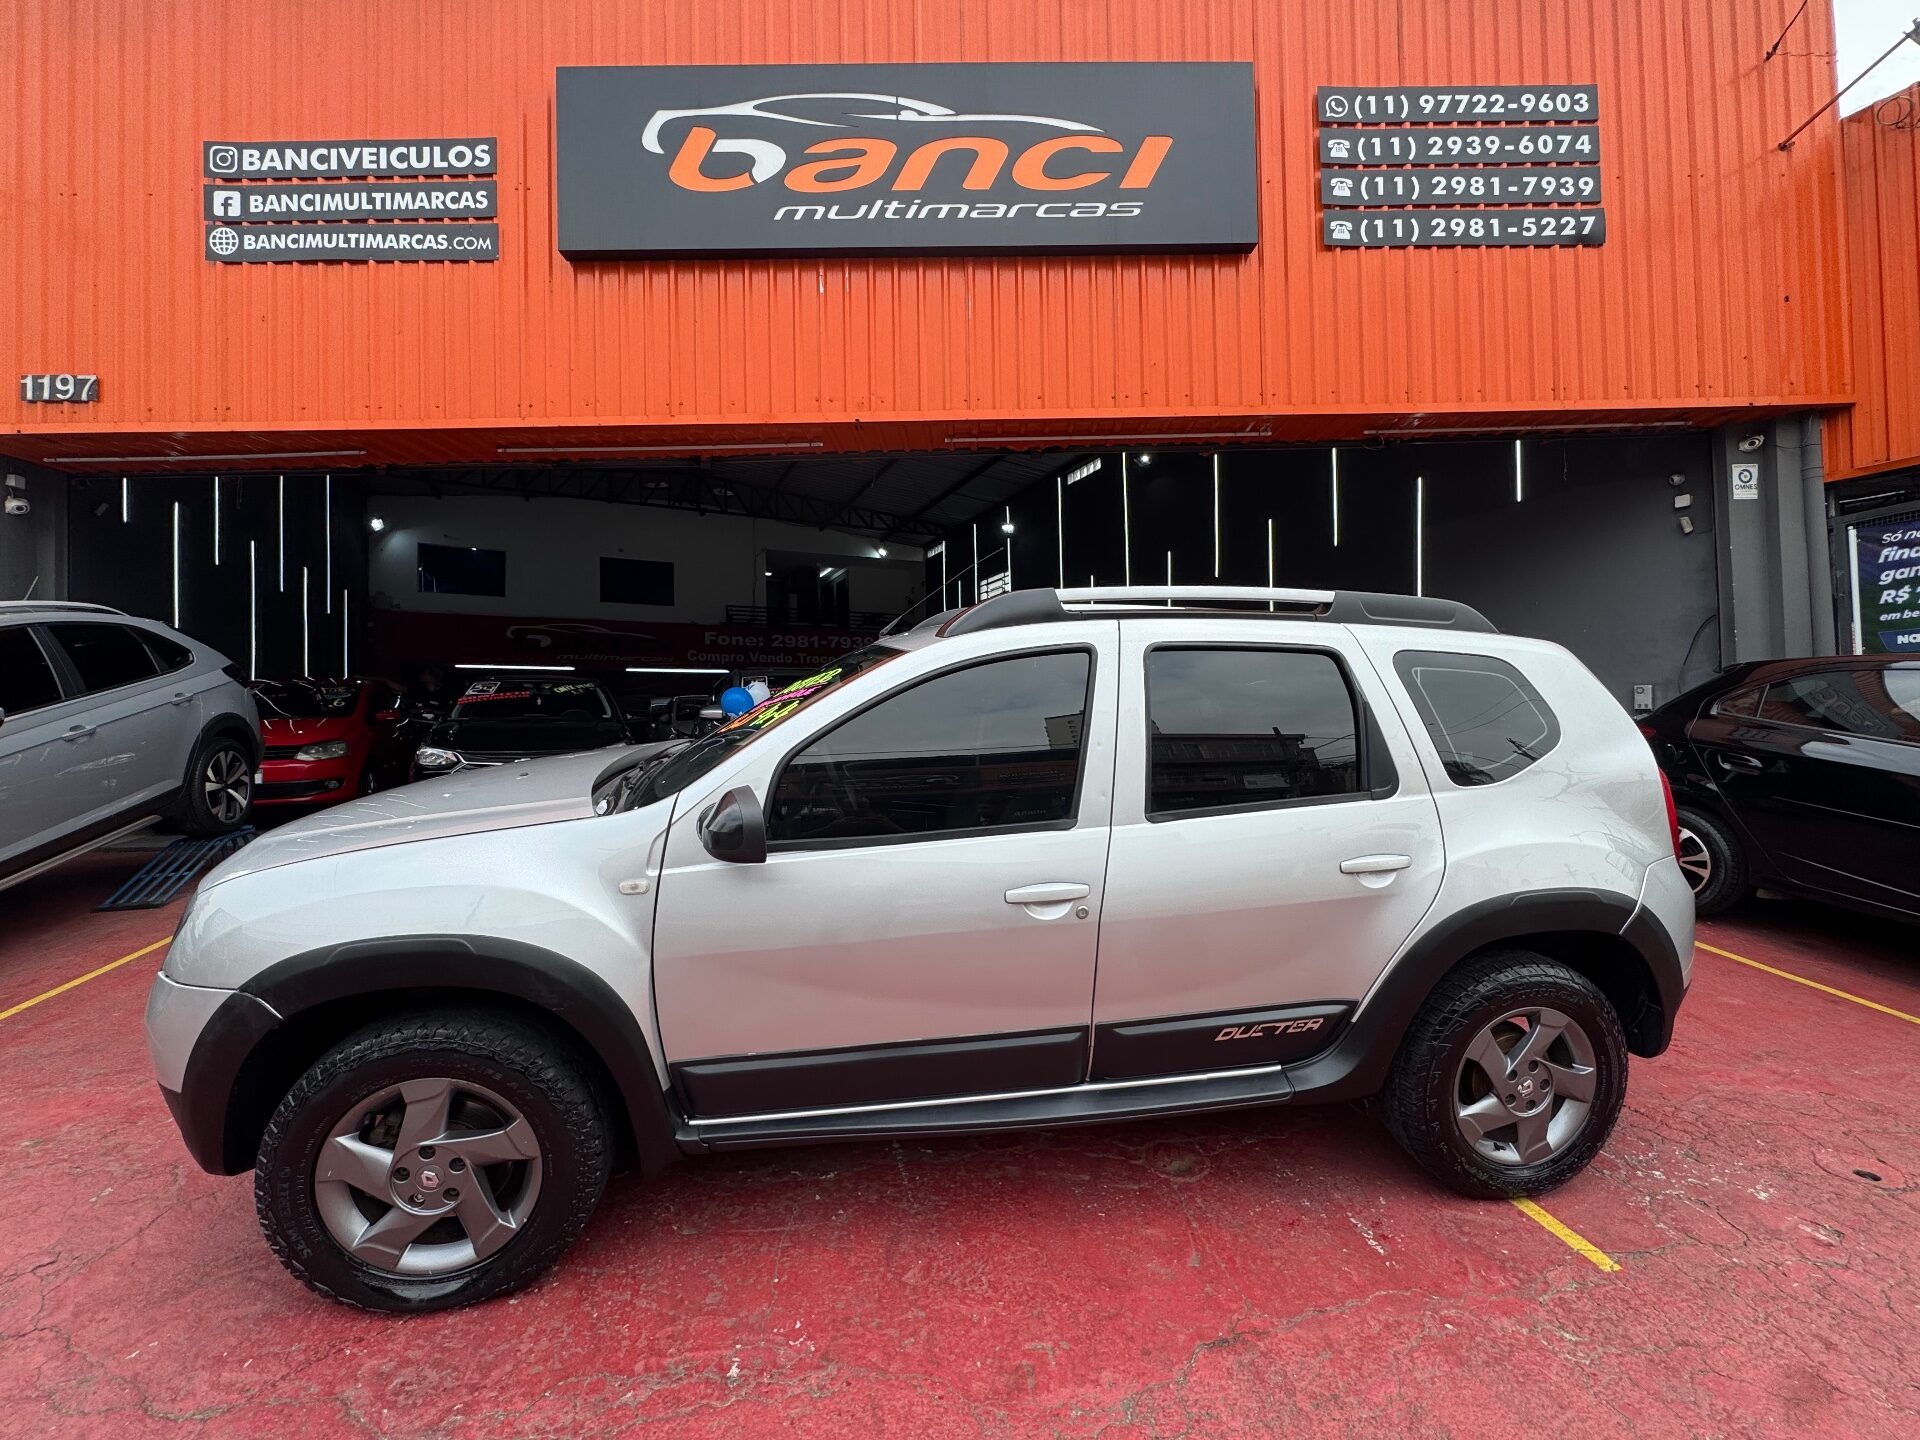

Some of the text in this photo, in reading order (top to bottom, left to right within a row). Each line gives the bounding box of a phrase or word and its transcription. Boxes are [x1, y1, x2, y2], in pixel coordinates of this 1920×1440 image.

[1354, 93, 1590, 120] (11) 97722-9603
[242, 144, 491, 171] BANCIVEICULOS
[668, 126, 1173, 193] banci
[1357, 134, 1592, 161] (11) 2939-6074
[1360, 175, 1594, 200] (11) 2981-7939
[249, 190, 489, 213] BANCIMULTIMARCAS
[772, 199, 1144, 221] multimarcas
[243, 233, 492, 250] BANCIMULTIMARCAS.COM
[1359, 215, 1596, 243] (11) 2981-5227
[20, 373, 97, 401] 1197
[1881, 529, 1904, 544] Só
[1879, 585, 1912, 604] R$
[1879, 612, 1901, 622] em
[704, 631, 764, 647] Fone:
[1214, 1017, 1324, 1042] DUSTER
